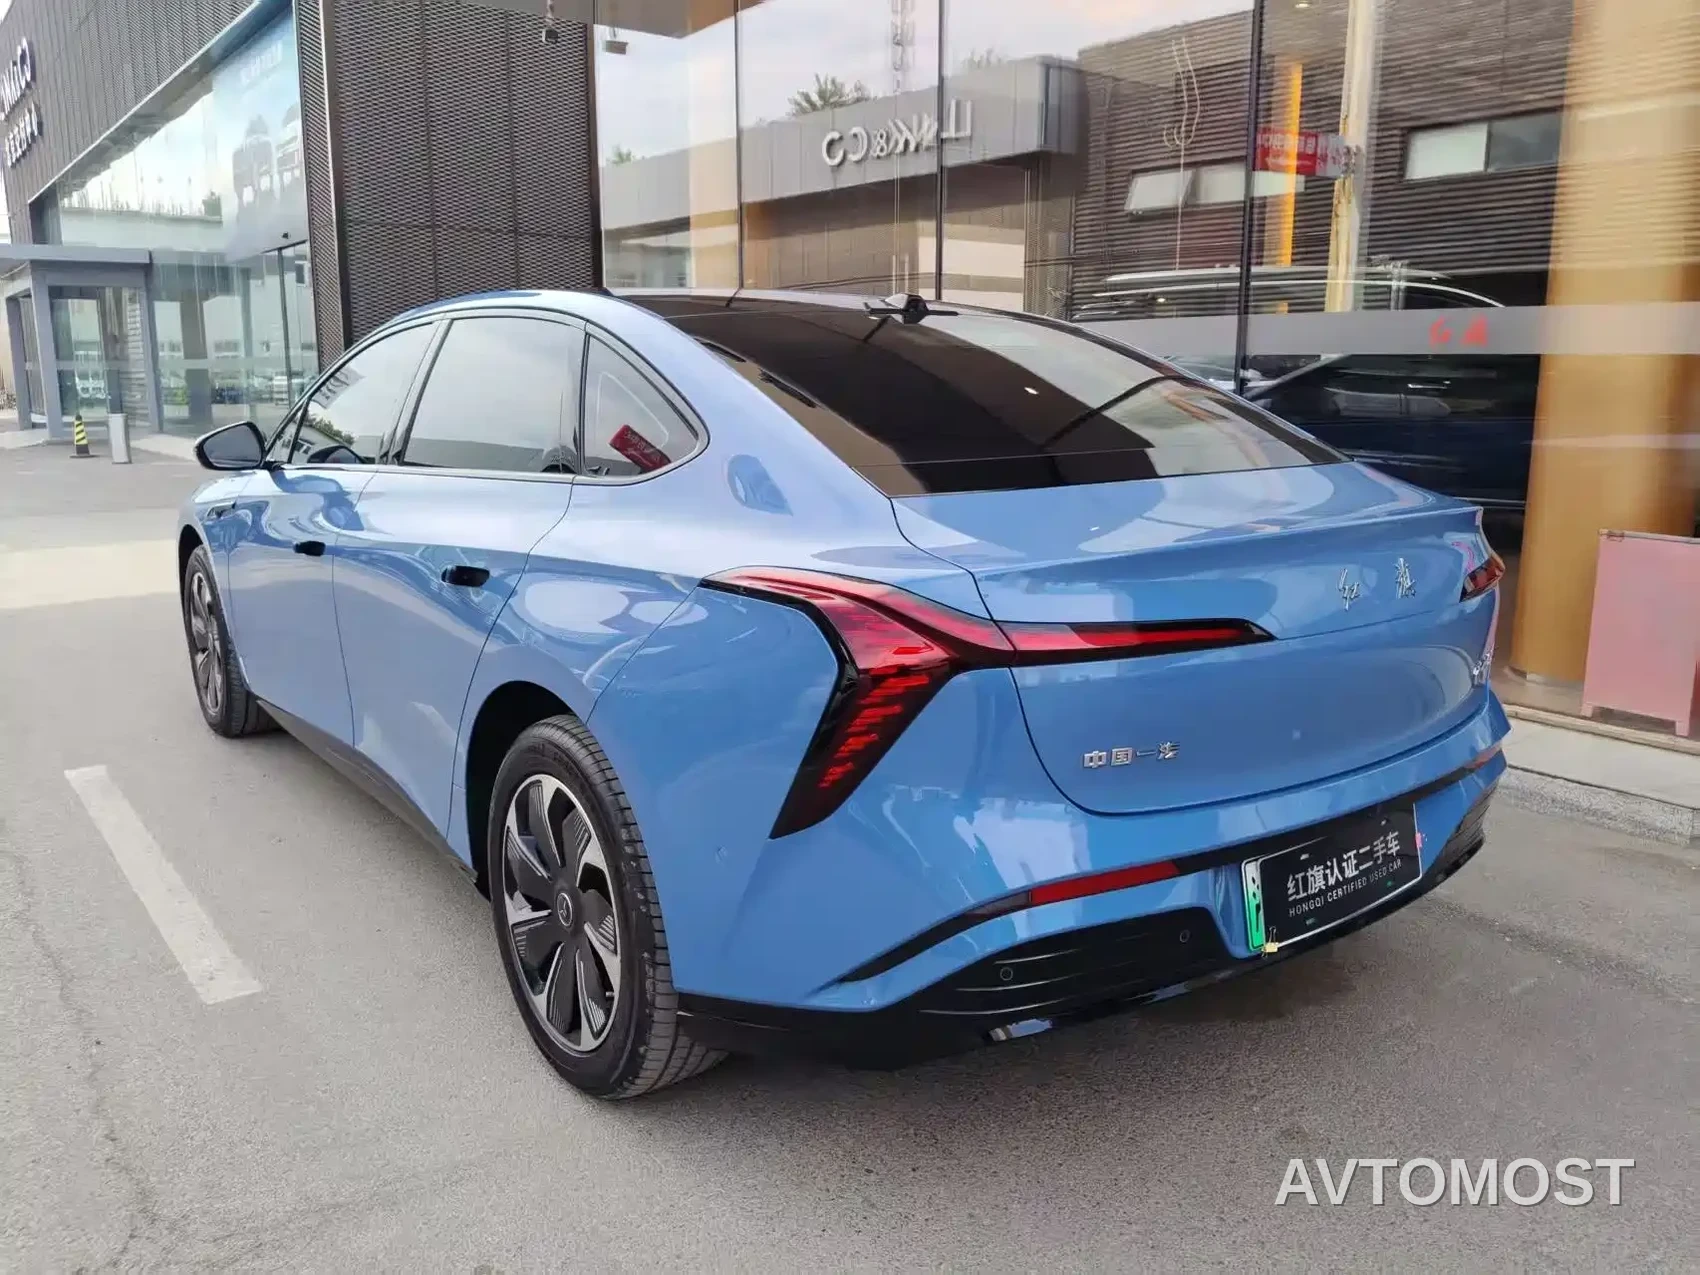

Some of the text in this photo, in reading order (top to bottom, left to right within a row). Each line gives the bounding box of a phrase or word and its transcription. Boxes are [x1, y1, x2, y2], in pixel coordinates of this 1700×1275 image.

[1083, 741, 1181, 769] 中国一汽
[1287, 831, 1400, 901] 红旗认证二手车
[1289, 858, 1402, 918] HONGQI CERTIFIED USED CAR
